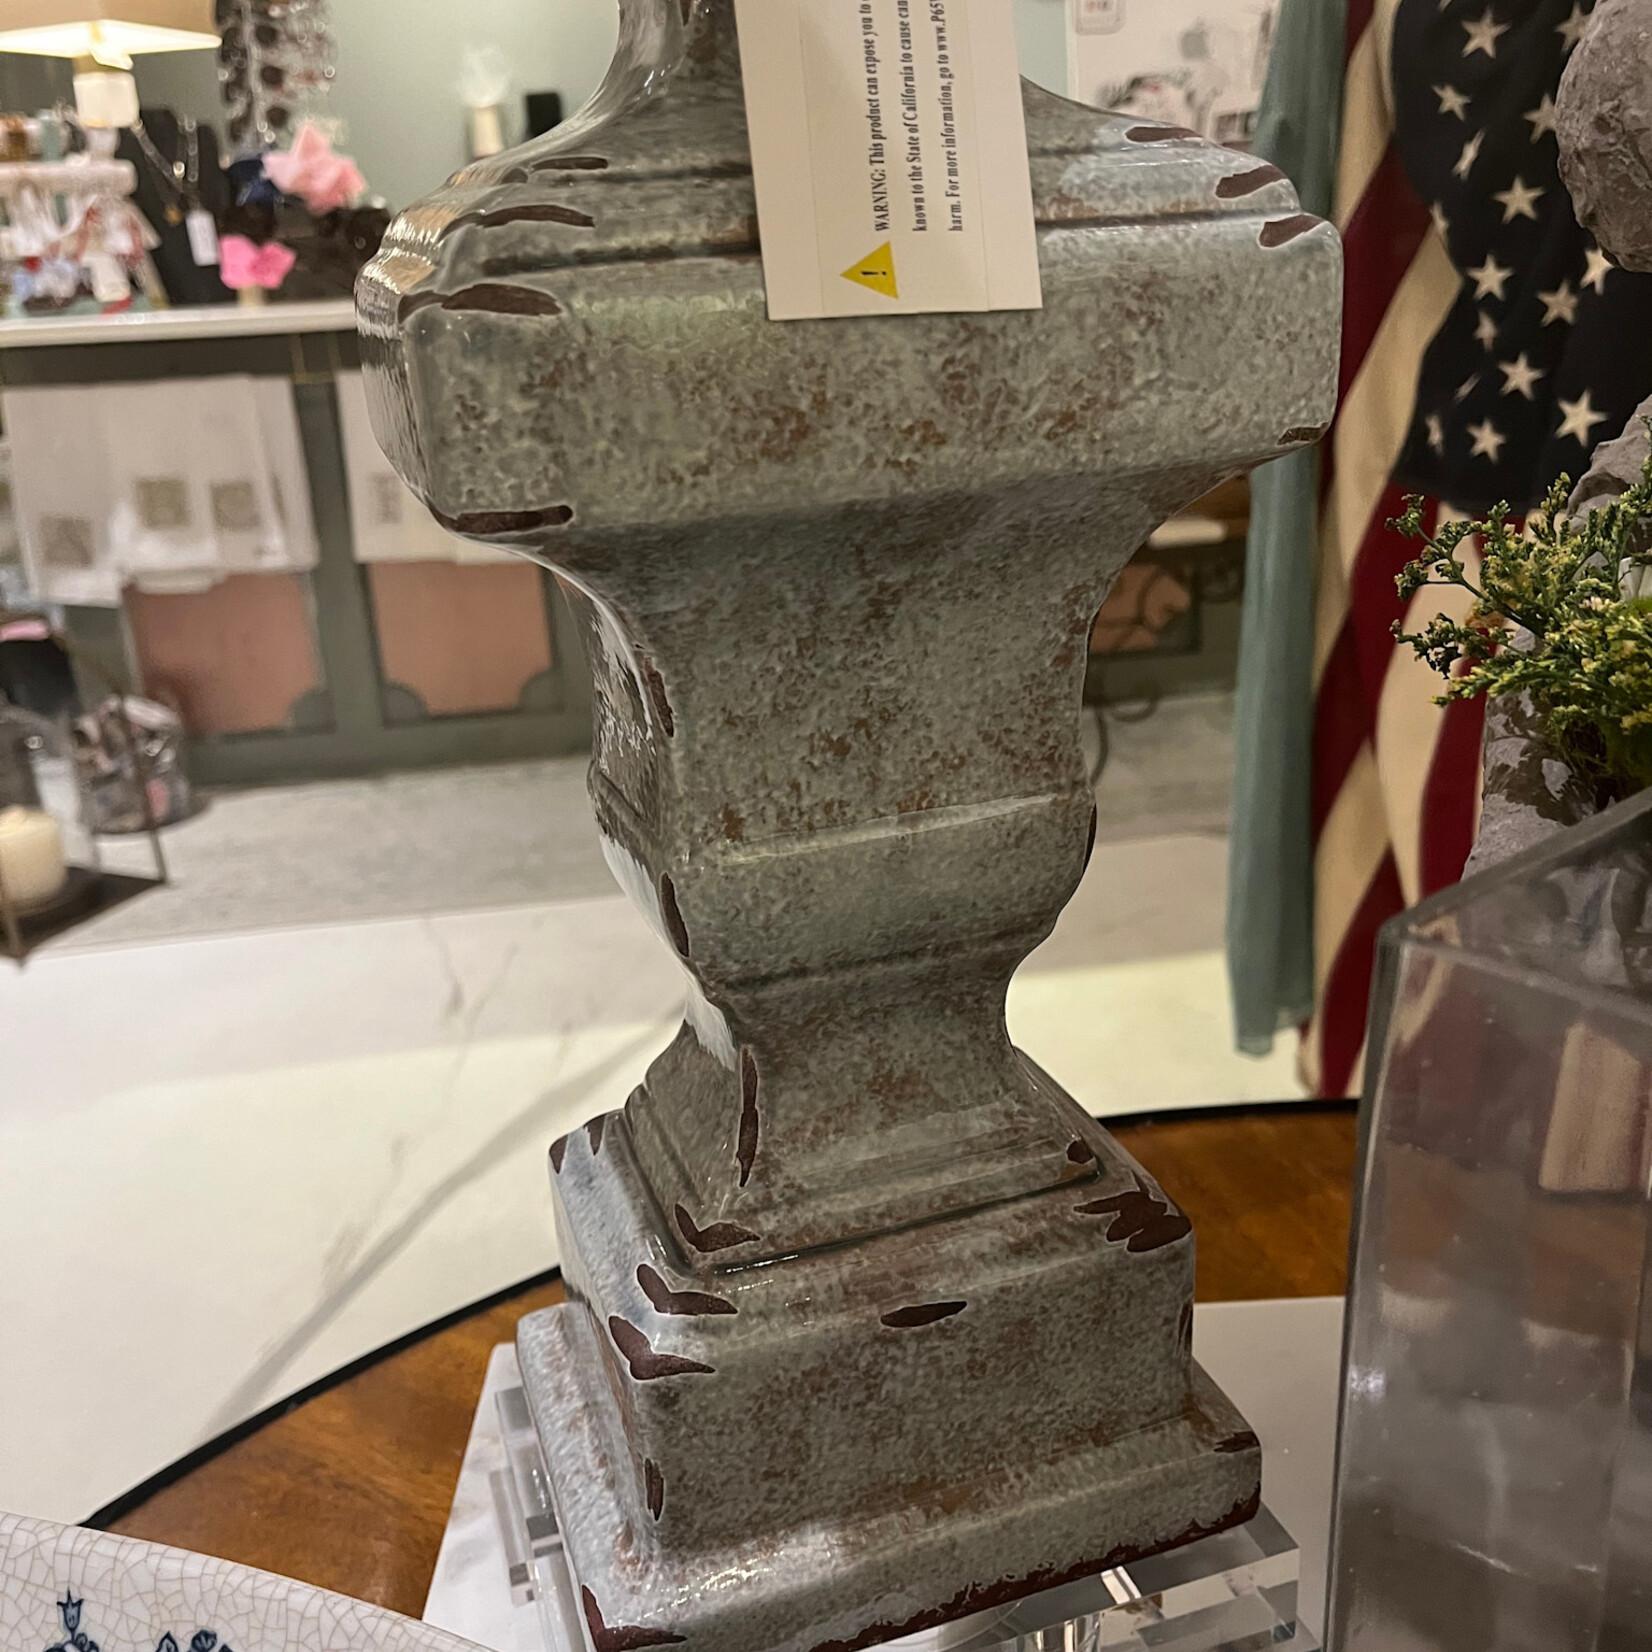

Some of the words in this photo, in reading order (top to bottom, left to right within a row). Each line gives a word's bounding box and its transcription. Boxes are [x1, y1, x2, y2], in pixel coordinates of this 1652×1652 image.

[859, 4, 872, 14] to
[862, 17, 878, 36] you
[899, 21, 912, 50] cause
[864, 39, 881, 74] expose
[899, 53, 913, 63] to
[936, 54, 949, 64] to
[939, 67, 955, 79] go
[867, 77, 879, 95] can
[899, 66, 918, 121] California
[866, 99, 887, 140] product
[938, 82, 957, 148] information,
[903, 122, 919, 133] of
[869, 143, 885, 166] This
[906, 136, 921, 163] State
[908, 165, 923, 181] the
[946, 150, 959, 177] more
[870, 169, 890, 231] WARNING:
[911, 184, 925, 194] to
[945, 180, 960, 197] For
[912, 197, 927, 231] known
[948, 201, 963, 231] harm.
